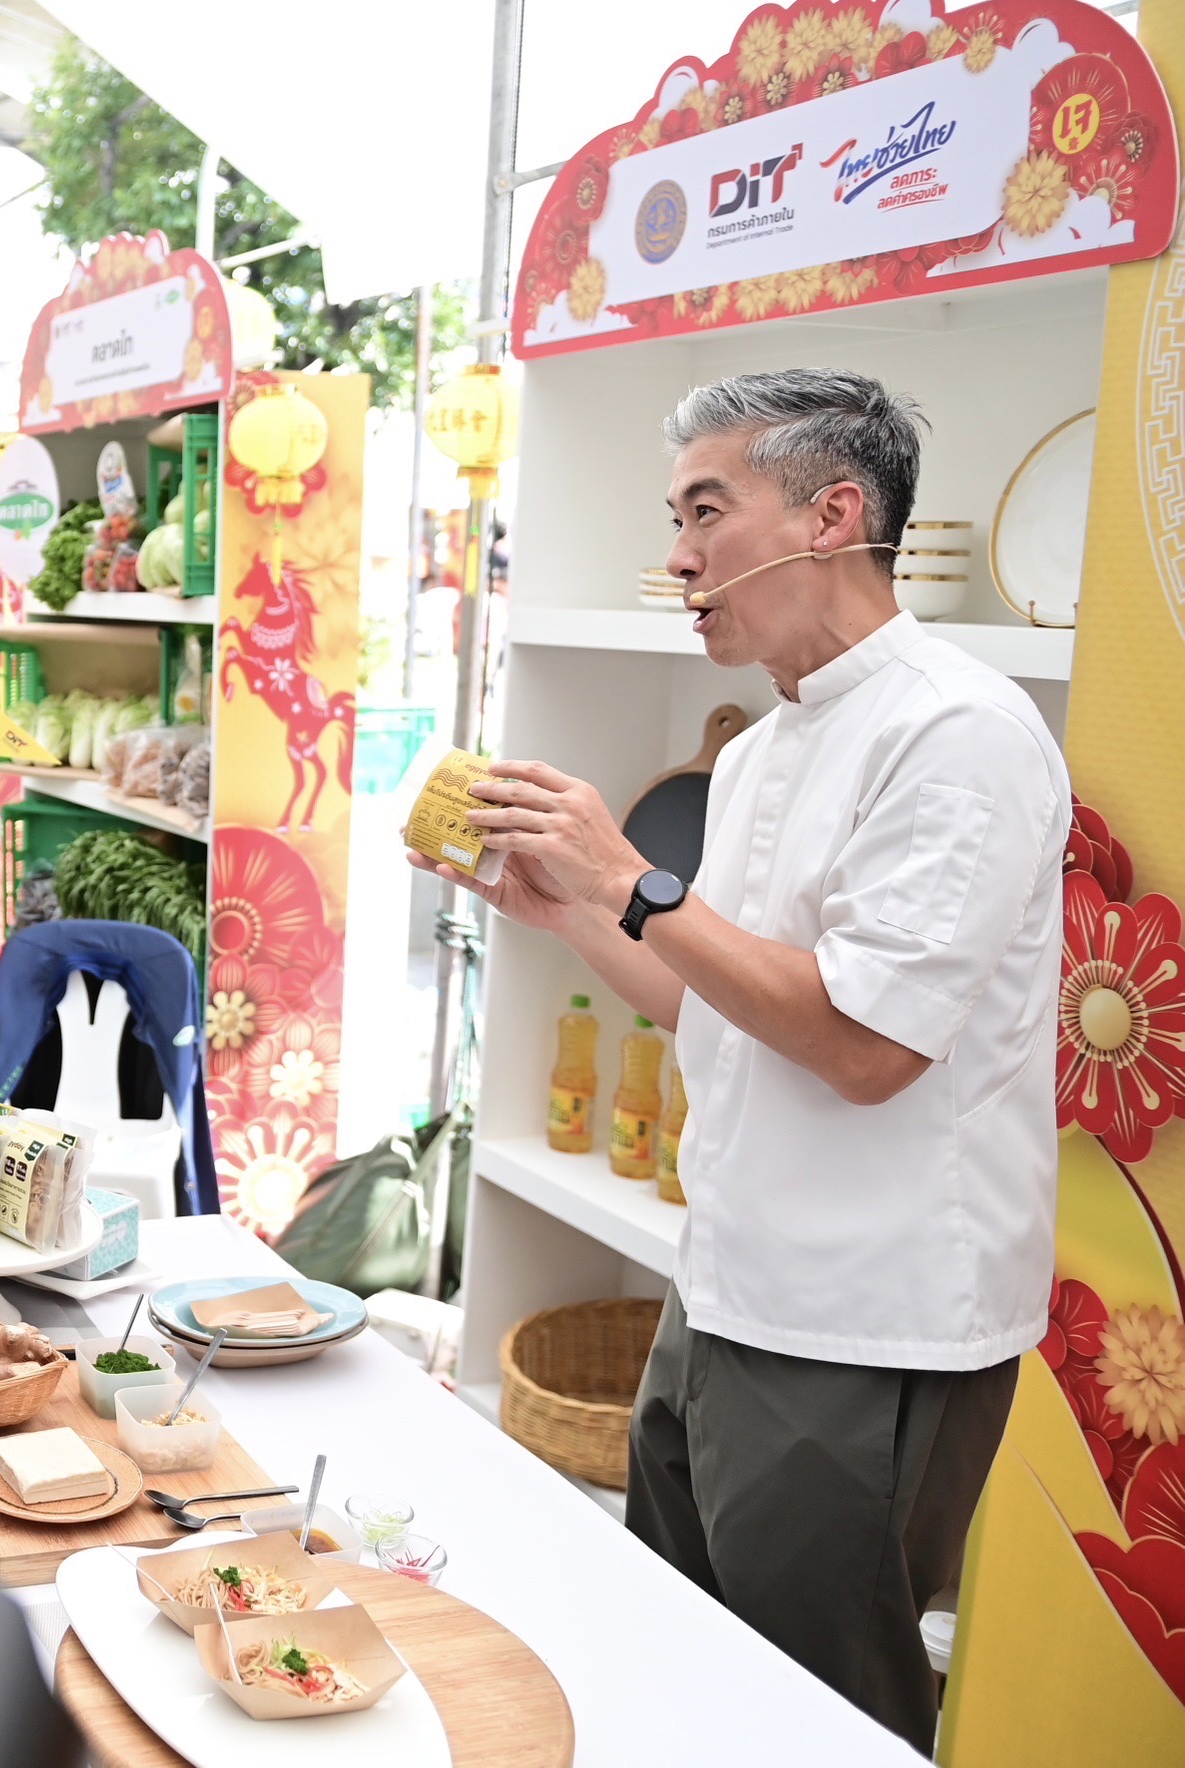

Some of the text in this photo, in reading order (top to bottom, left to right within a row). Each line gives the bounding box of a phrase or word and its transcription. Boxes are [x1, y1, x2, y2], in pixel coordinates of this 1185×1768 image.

[820, 101, 956, 202] ไทยช่วยไทย
[890, 168, 937, 189] ลดภาระ
[877, 182, 948, 209] ลดค่าครองชีพ
[707, 207, 794, 238] กรมการค้าภายใน
